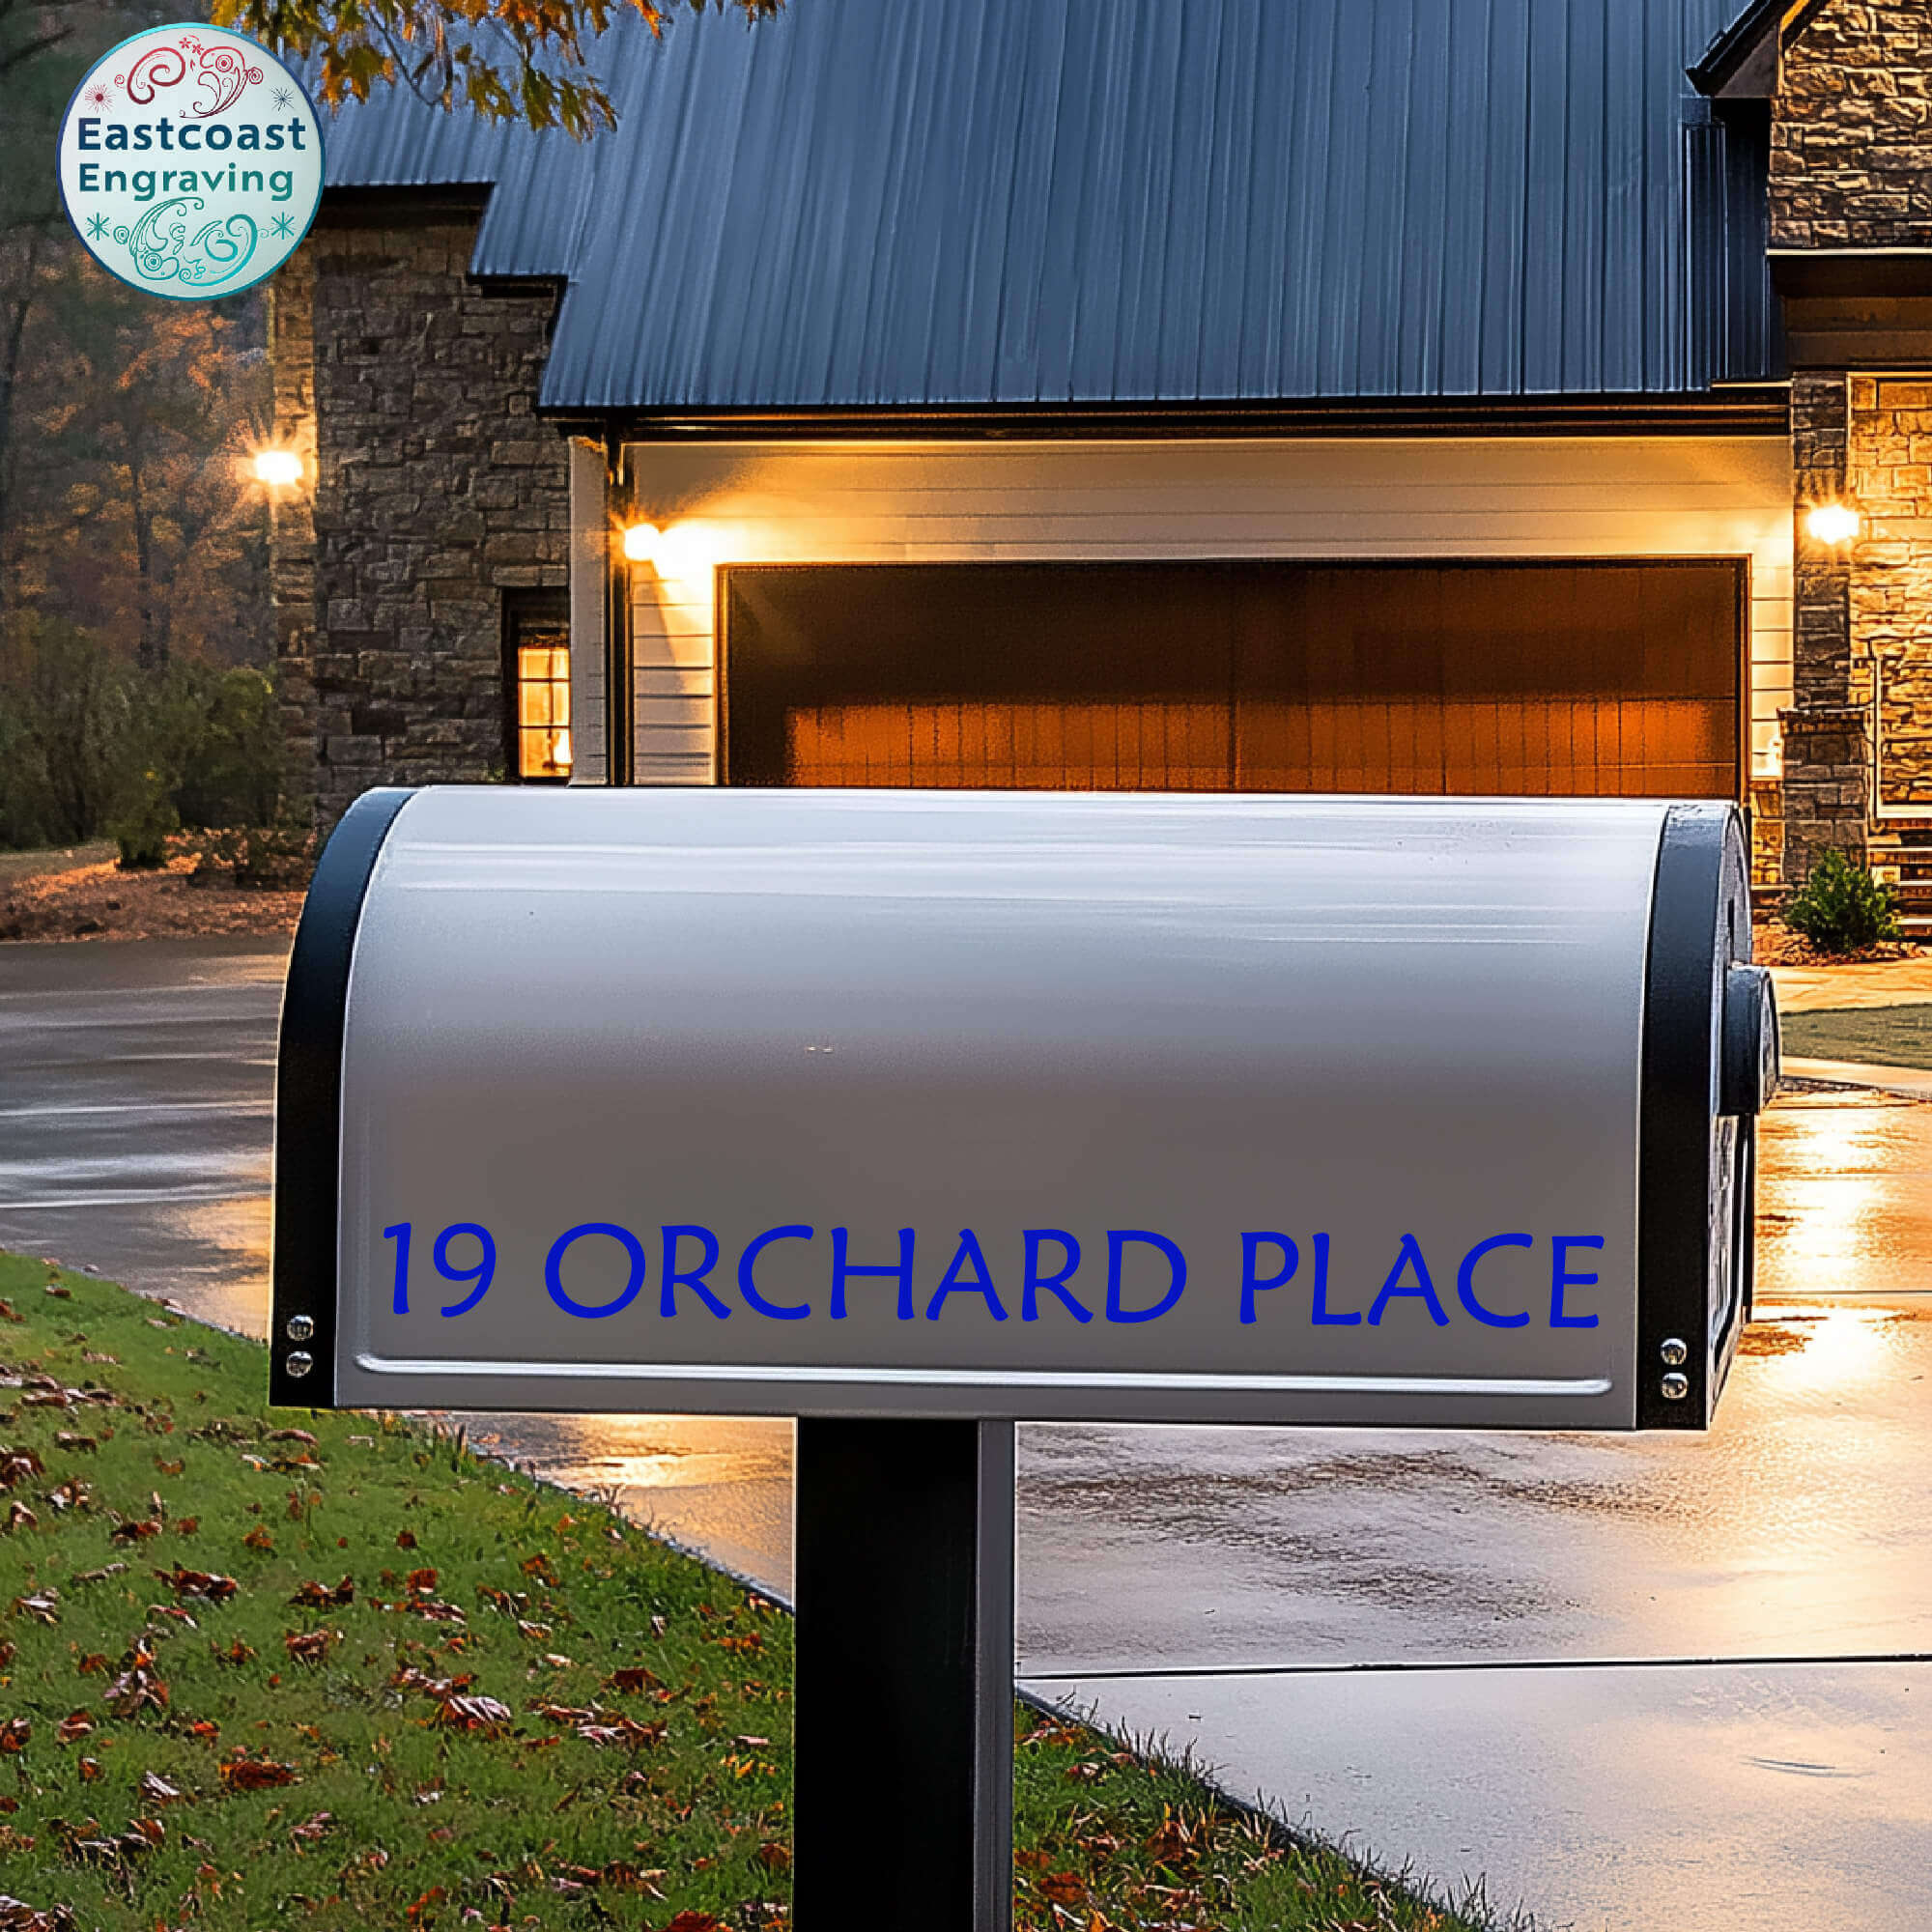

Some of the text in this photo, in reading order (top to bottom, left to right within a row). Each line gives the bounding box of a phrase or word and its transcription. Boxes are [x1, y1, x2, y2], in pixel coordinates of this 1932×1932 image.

[383, 1222, 1605, 1329] 19 ORCHARD PLACE
